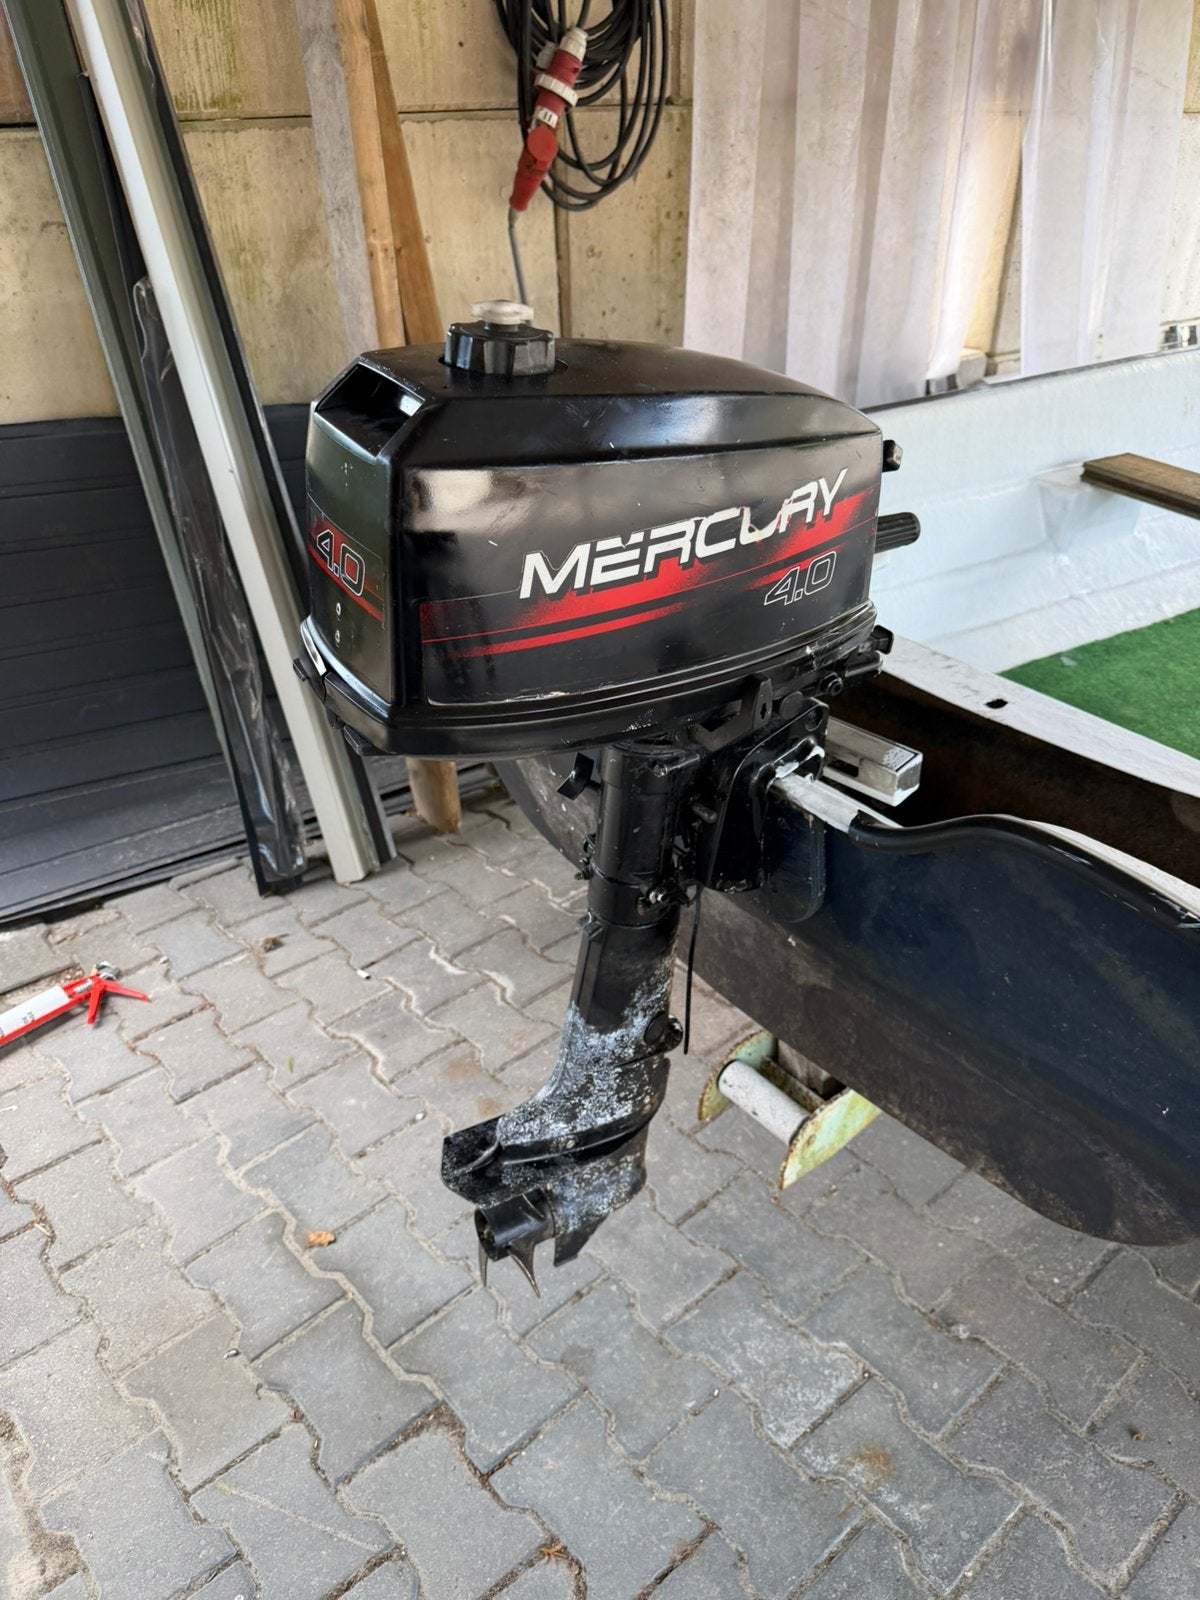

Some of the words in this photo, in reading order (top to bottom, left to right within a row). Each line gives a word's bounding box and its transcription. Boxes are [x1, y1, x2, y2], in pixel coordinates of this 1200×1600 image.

[316, 529, 366, 596] 4.0
[519, 468, 848, 599] MERCURY
[764, 551, 837, 606] 4.0
